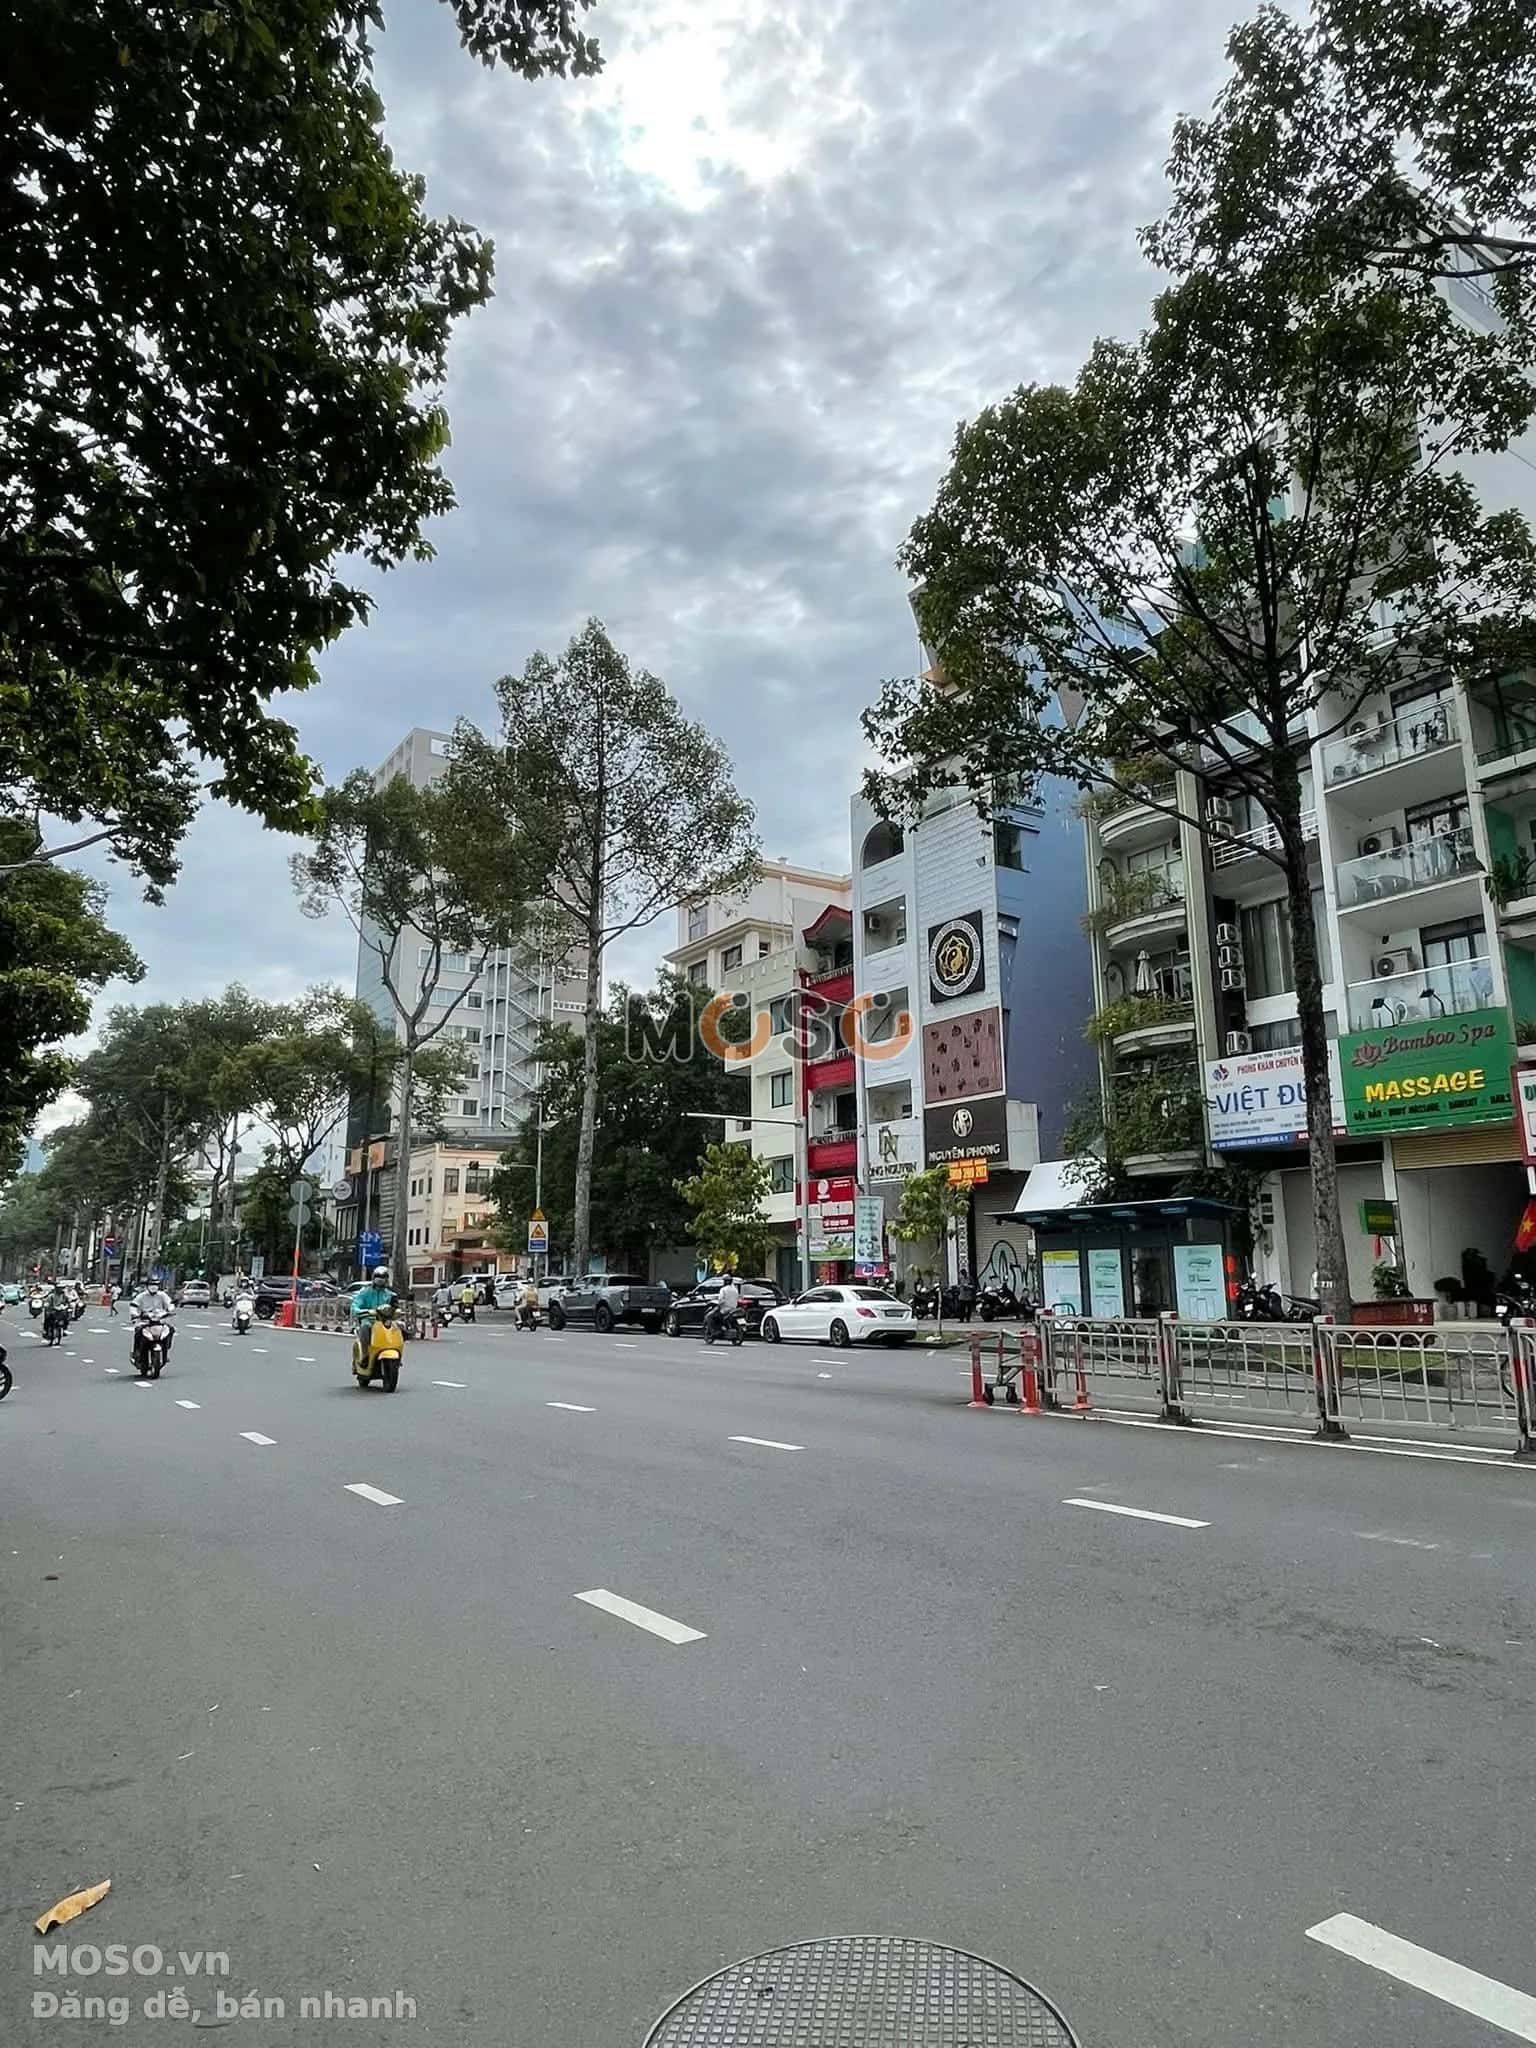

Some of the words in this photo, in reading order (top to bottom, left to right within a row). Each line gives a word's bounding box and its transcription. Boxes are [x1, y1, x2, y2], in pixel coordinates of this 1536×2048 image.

[1382, 1028, 1455, 1054] Bamboo
[1457, 1023, 1496, 1047] Spa
[1215, 1084, 1270, 1116] VIỆT
[1365, 1068, 1486, 1102] MASSAGE
[966, 1143, 1001, 1158] PHONG
